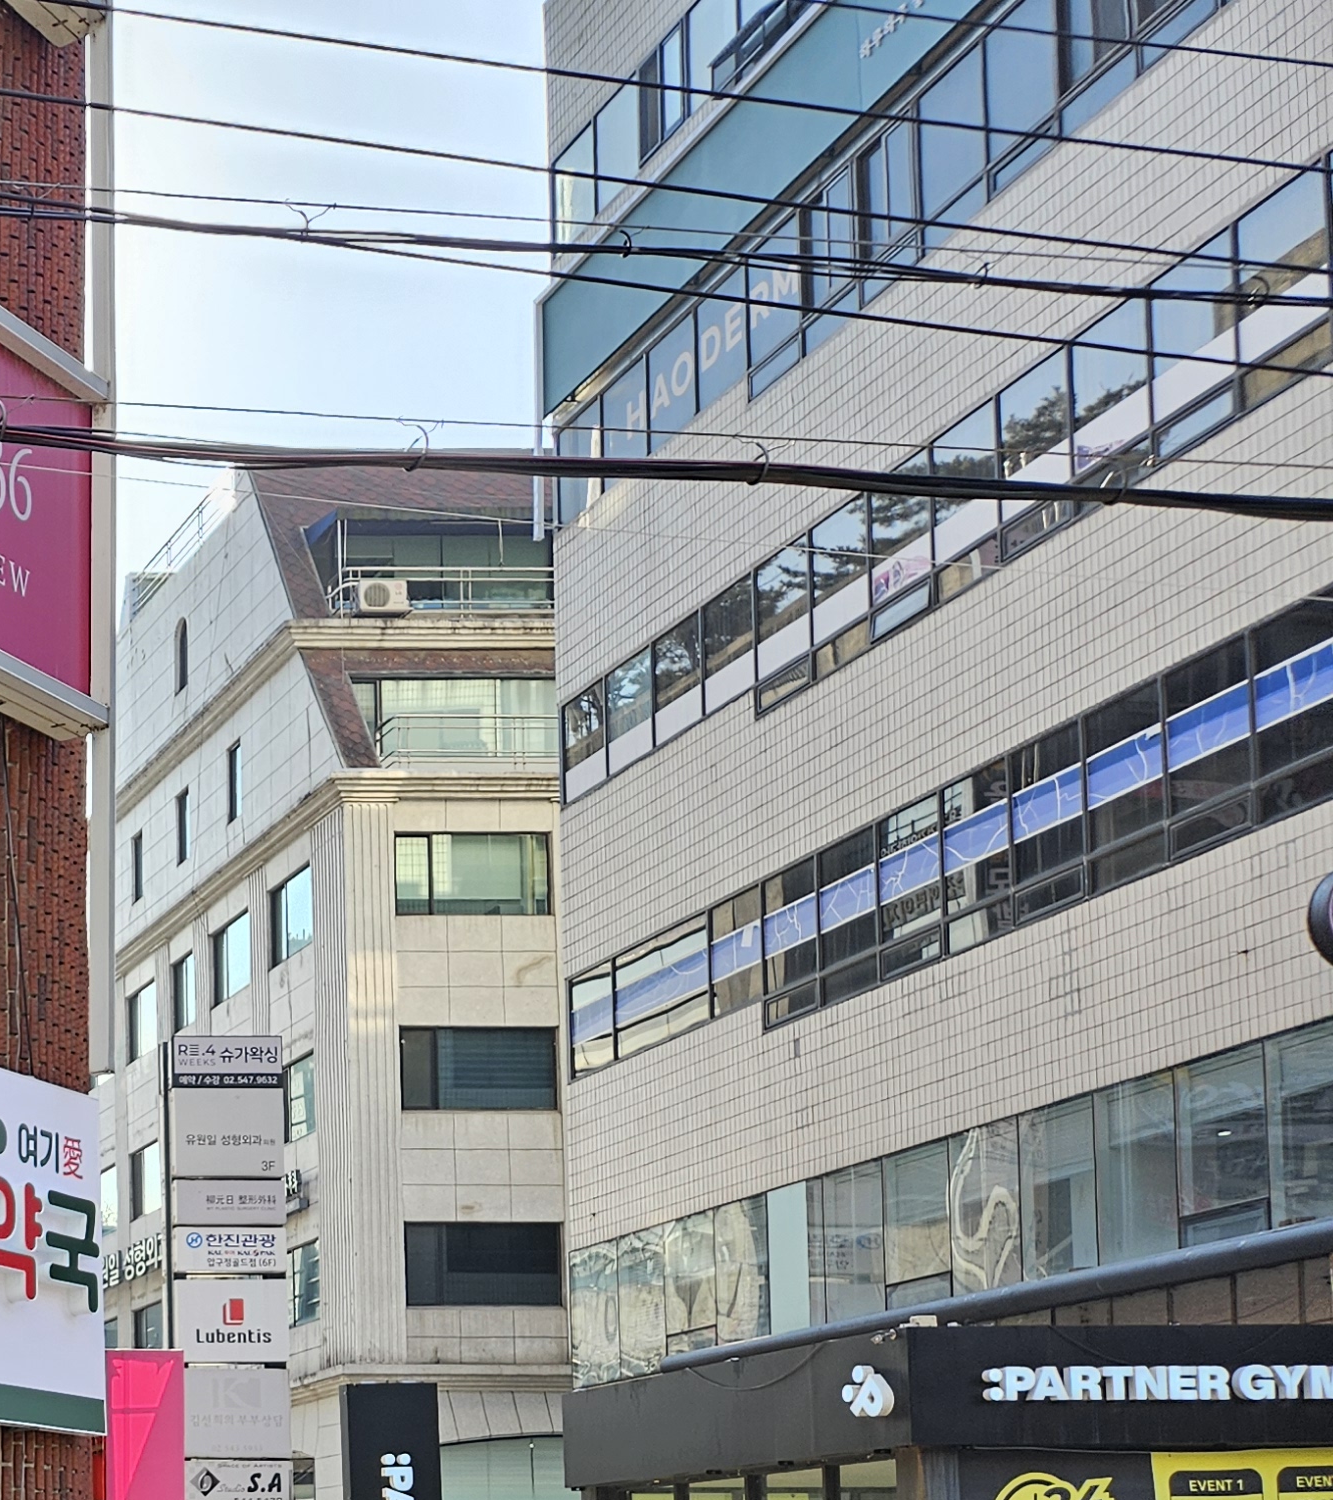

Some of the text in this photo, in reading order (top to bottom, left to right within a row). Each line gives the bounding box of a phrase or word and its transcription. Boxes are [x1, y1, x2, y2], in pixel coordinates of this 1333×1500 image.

[626, 265, 800, 440] HAODERM
[219, 1046, 278, 1063] 슈가왁싱
[178, 1058, 216, 1066] WEEKS
[186, 1134, 217, 1145] 유원일
[261, 1160, 276, 1171] 3F
[206, 1233, 276, 1248] 한진관광
[259, 1257, 277, 1268] (6F)
[195, 1328, 273, 1345] Lubentis
[247, 1472, 282, 1493] S.A
[1188, 1478, 1244, 1492] EVENT 1
[1296, 1476, 1333, 1488] EVEN
